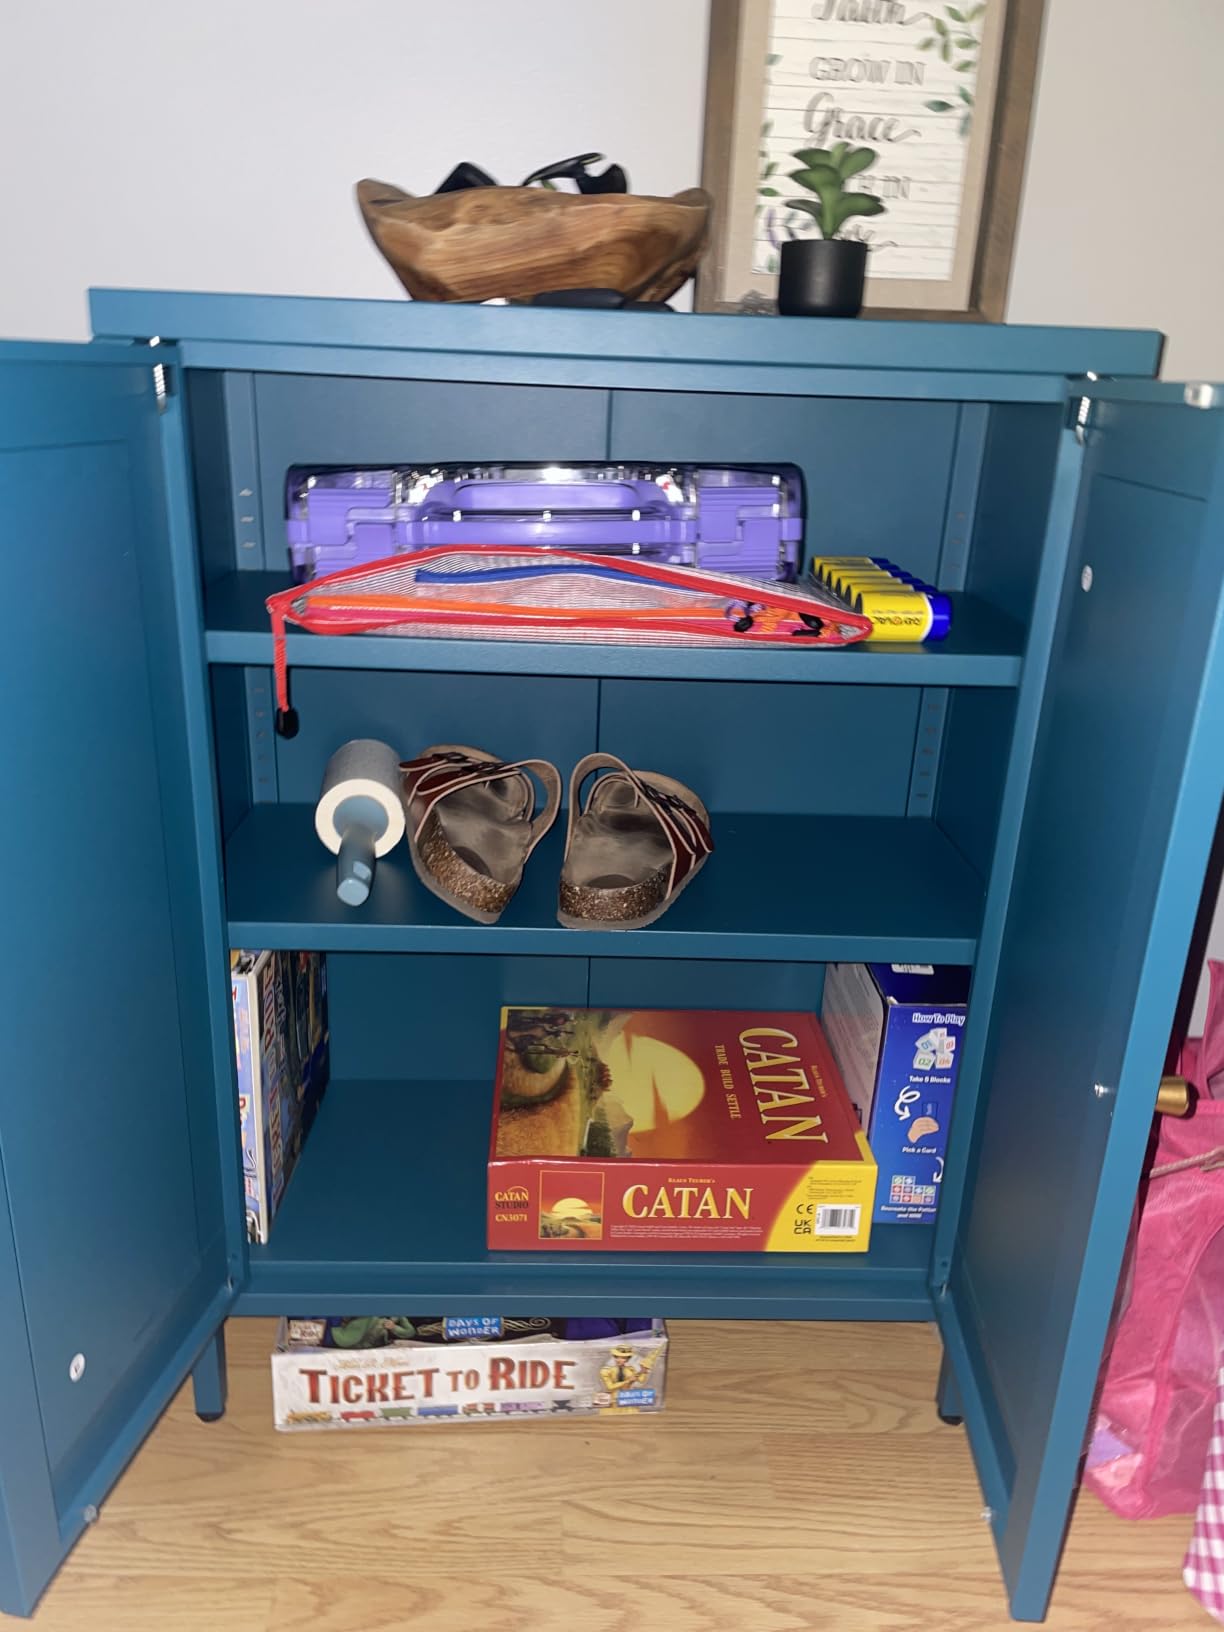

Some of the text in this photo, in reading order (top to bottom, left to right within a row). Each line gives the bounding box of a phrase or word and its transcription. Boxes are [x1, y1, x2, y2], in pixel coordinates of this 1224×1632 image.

[809, 56, 926, 86] GROW IN
[912, 1012, 966, 1027] How To Play
[714, 1044, 742, 1119] TRADE BUILD SETTLE
[739, 1027, 829, 1143] CATAN
[495, 1191, 529, 1202] CATAN
[622, 1184, 754, 1220] CATAN
[495, 1201, 529, 1209] STUDIO
[495, 1213, 528, 1222] CN3071
[448, 1317, 499, 1328] DAYS OF
[448, 1327, 500, 1336] WONDER
[299, 1356, 578, 1404] TICKET TO RIDE
